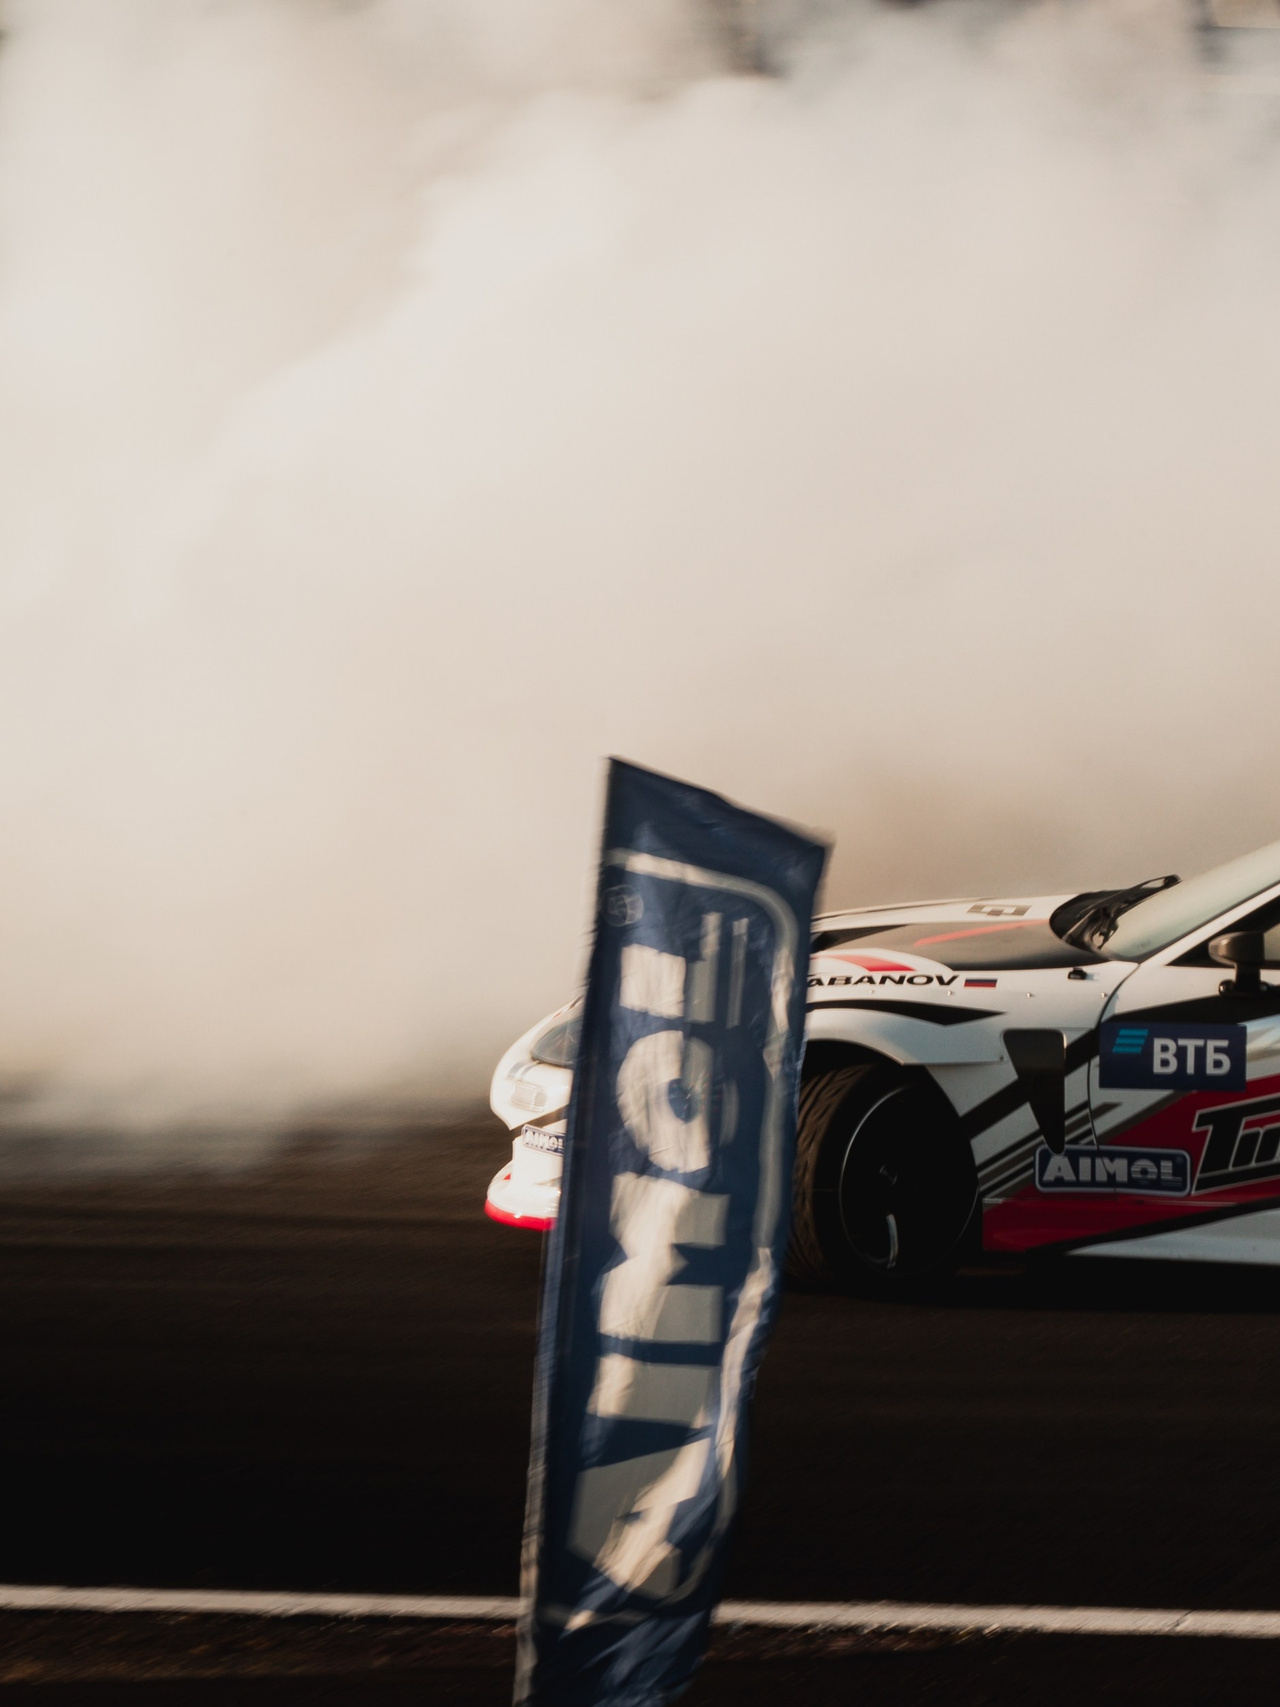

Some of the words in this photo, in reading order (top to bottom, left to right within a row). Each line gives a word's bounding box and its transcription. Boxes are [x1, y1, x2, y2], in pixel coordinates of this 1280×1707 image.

[806, 973, 959, 989] ABANOV
[1152, 1036, 1231, 1077] ВТБ
[1042, 1155, 1183, 1188] AIMOL
